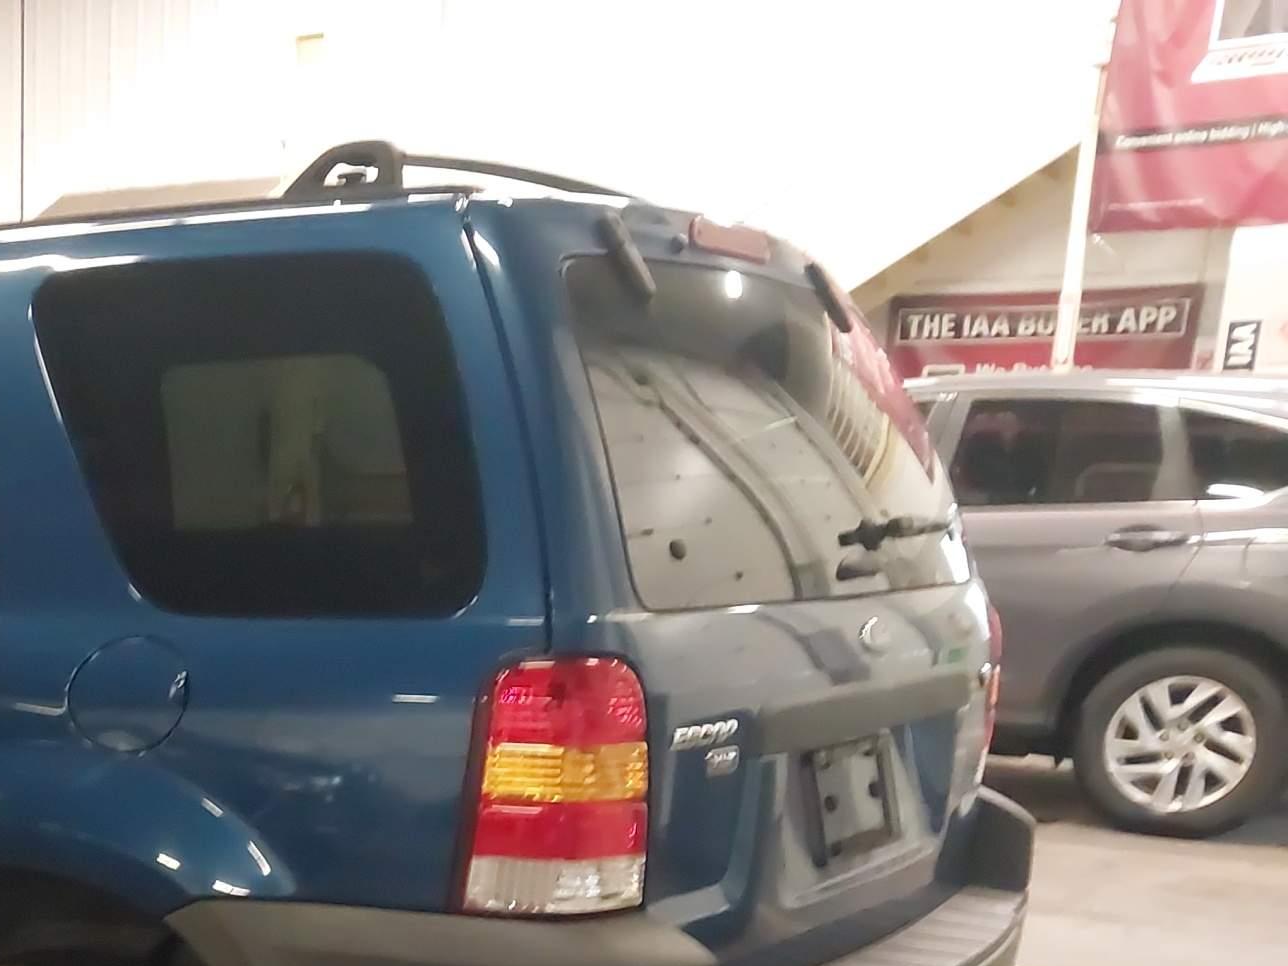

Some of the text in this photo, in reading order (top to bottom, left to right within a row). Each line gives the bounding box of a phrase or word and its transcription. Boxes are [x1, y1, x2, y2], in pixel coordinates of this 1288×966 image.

[907, 304, 1178, 338] THE IAA BUER APP
